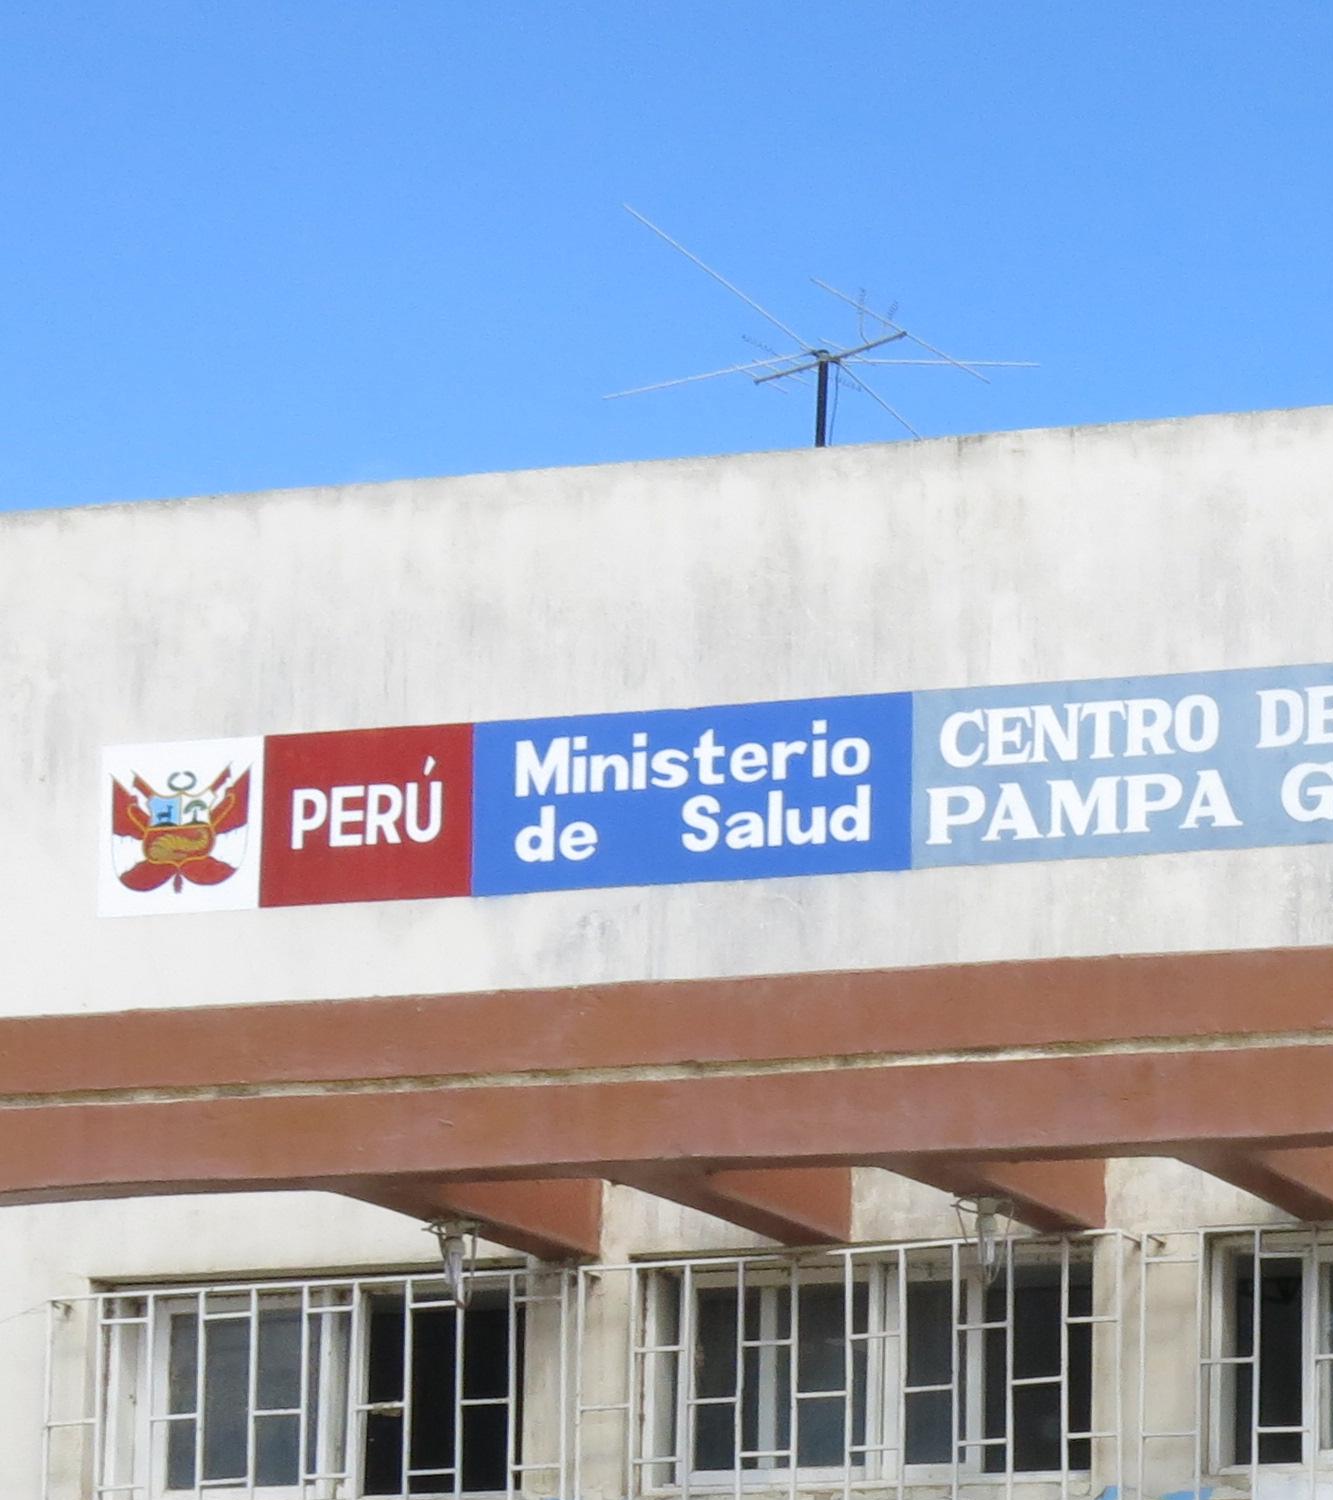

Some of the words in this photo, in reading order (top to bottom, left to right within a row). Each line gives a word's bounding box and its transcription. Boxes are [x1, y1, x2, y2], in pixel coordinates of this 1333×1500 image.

[514, 718, 872, 798] Ministerio
[939, 692, 1220, 769] CENTRO
[290, 756, 443, 851] PERÚ
[514, 812, 599, 865] de
[681, 784, 873, 853] Salud
[926, 768, 1244, 846] PAMPA
